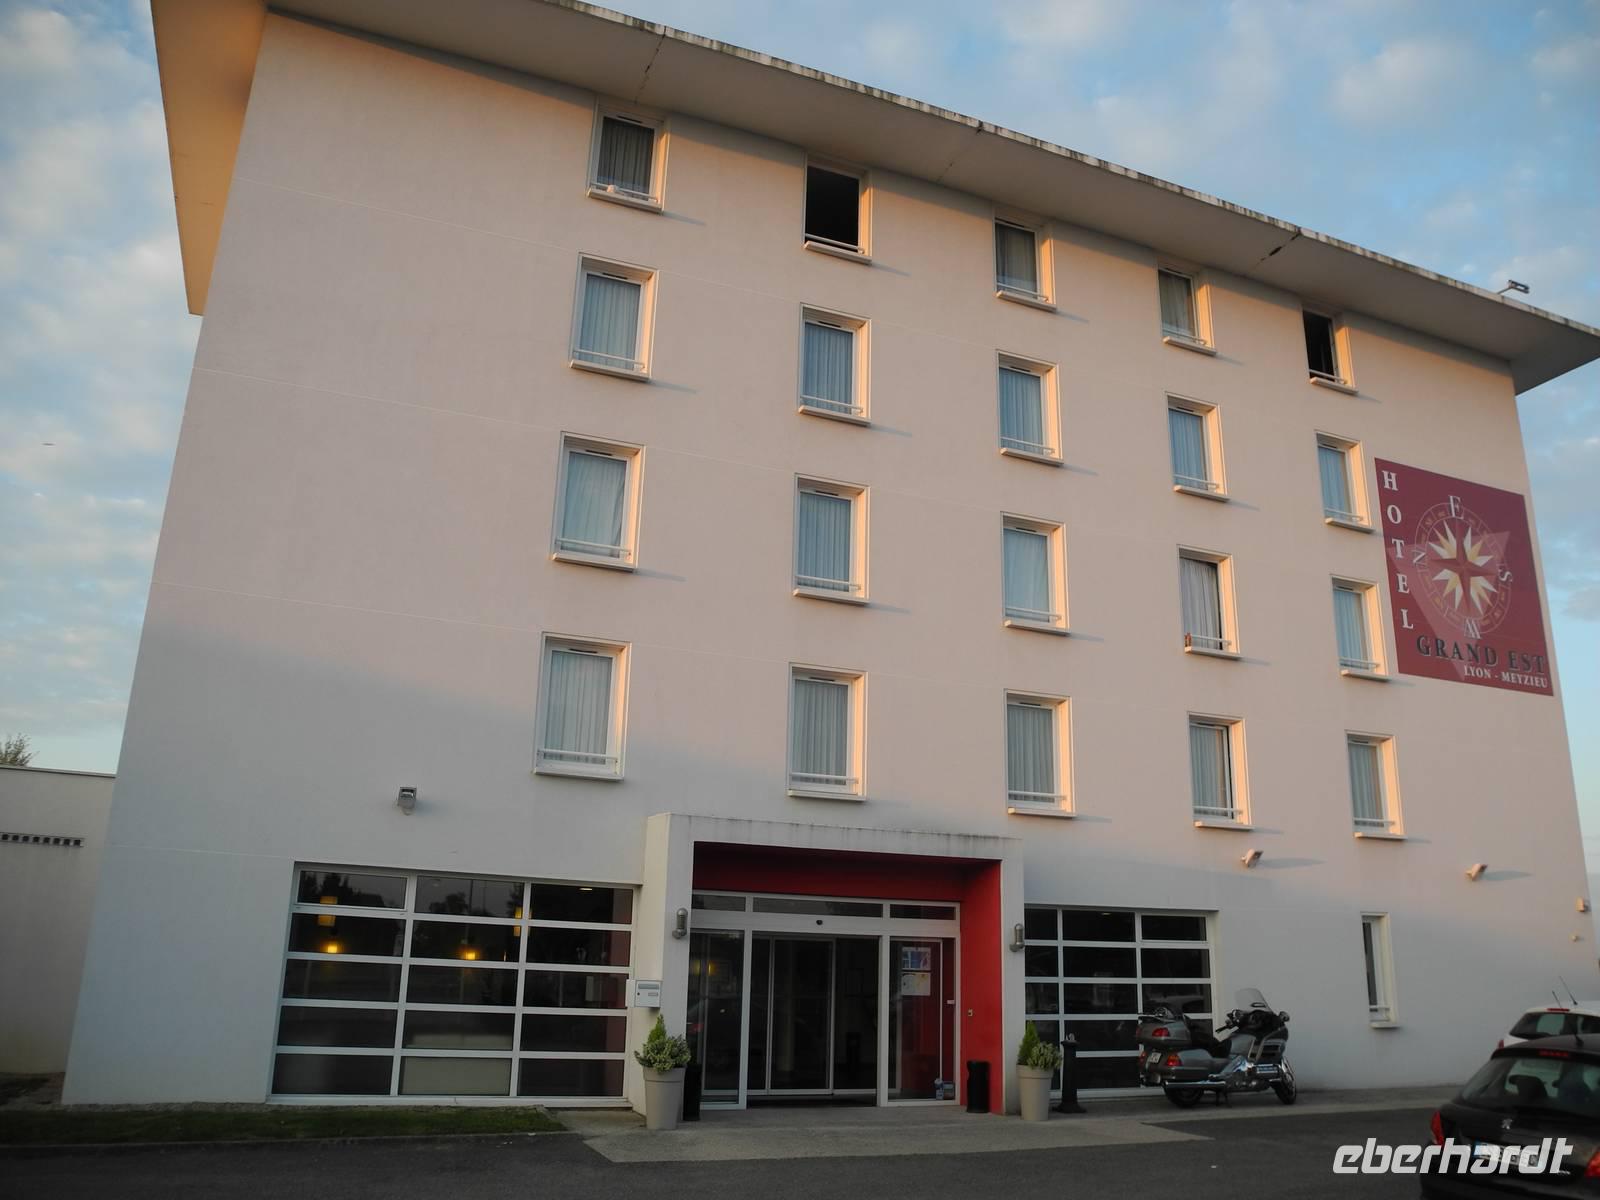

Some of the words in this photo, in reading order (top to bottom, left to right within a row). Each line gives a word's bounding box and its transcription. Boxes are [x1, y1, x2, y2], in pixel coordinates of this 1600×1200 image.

[1382, 470, 1414, 629] HOTEL
[1416, 635, 1498, 666] GRAND
[1508, 650, 1545, 674] EST
[1464, 665, 1492, 679] LYON
[1501, 671, 1548, 688] MEYZIEU
